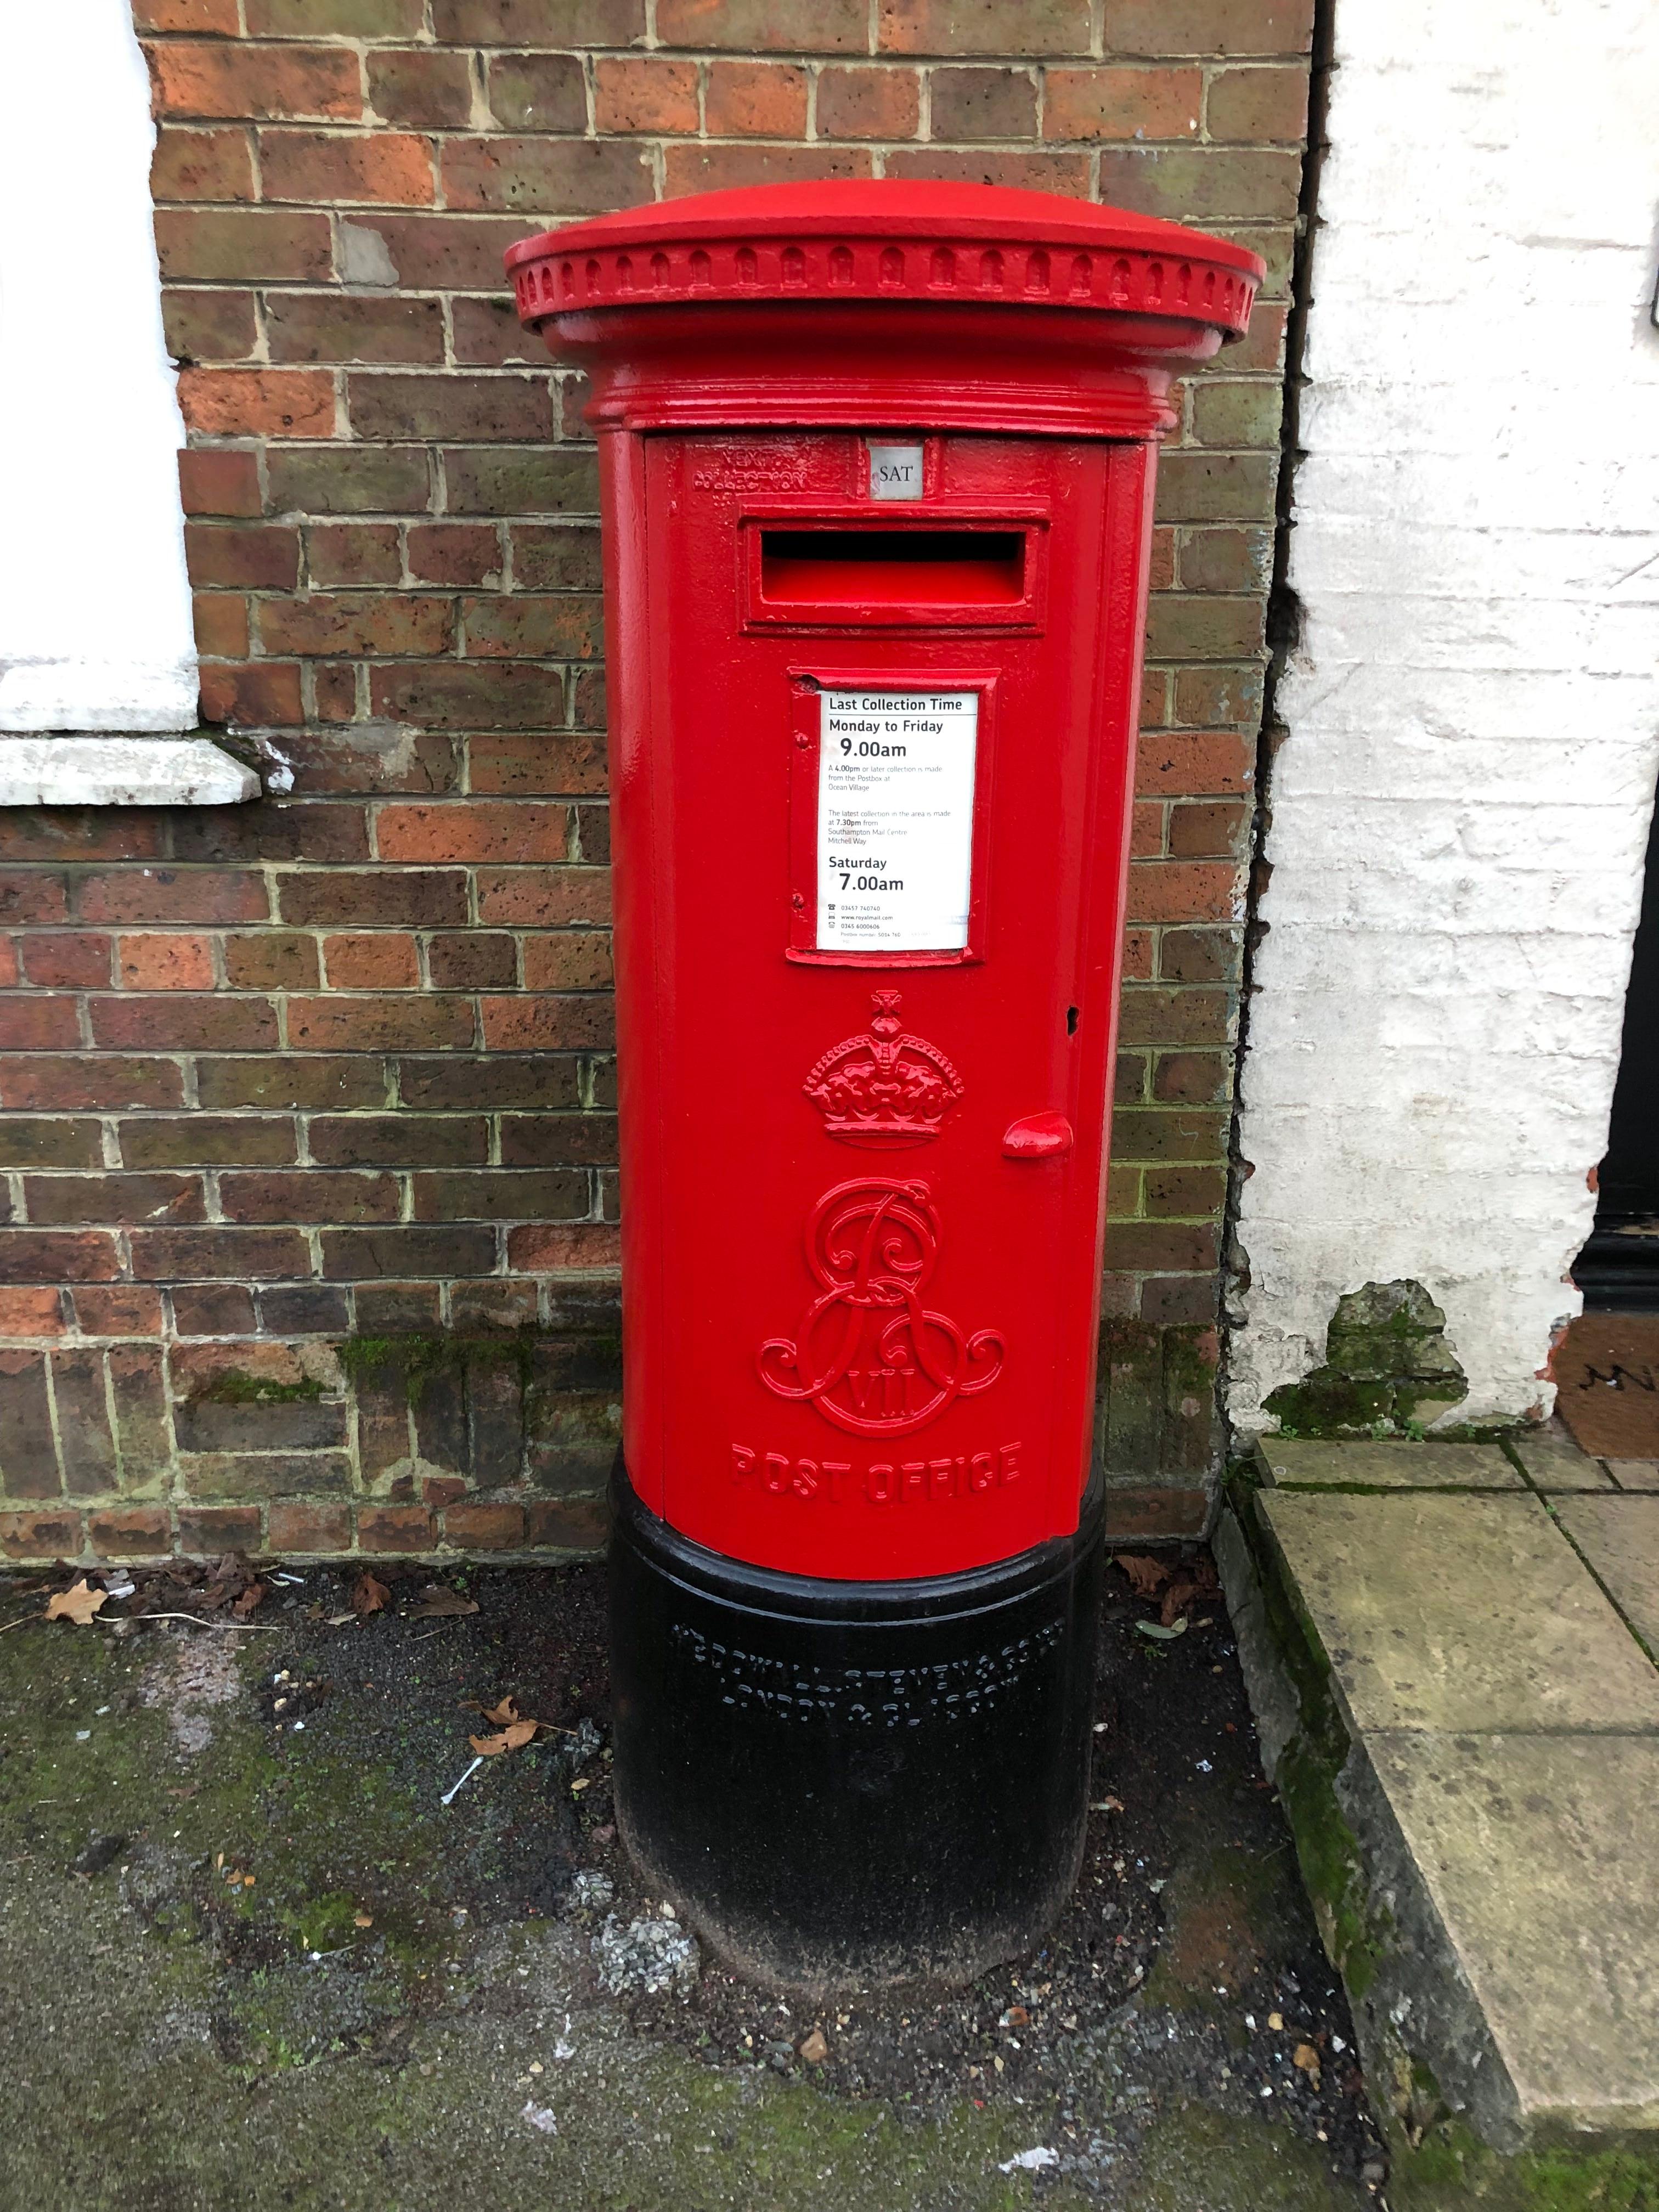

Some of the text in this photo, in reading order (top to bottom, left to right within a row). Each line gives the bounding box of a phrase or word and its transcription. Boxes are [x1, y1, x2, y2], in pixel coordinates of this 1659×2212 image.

[879, 466, 913, 481] SAT
[830, 697, 962, 710] Last Collection Time
[830, 719, 943, 733] Monday to Friday
[840, 738, 906, 757] 9.00am
[836, 819, 861, 827] 7.30pm
[829, 856, 887, 871] Saturday
[839, 873, 904, 890] 7.00am
[731, 1441, 1023, 1503] POST OFFICE
